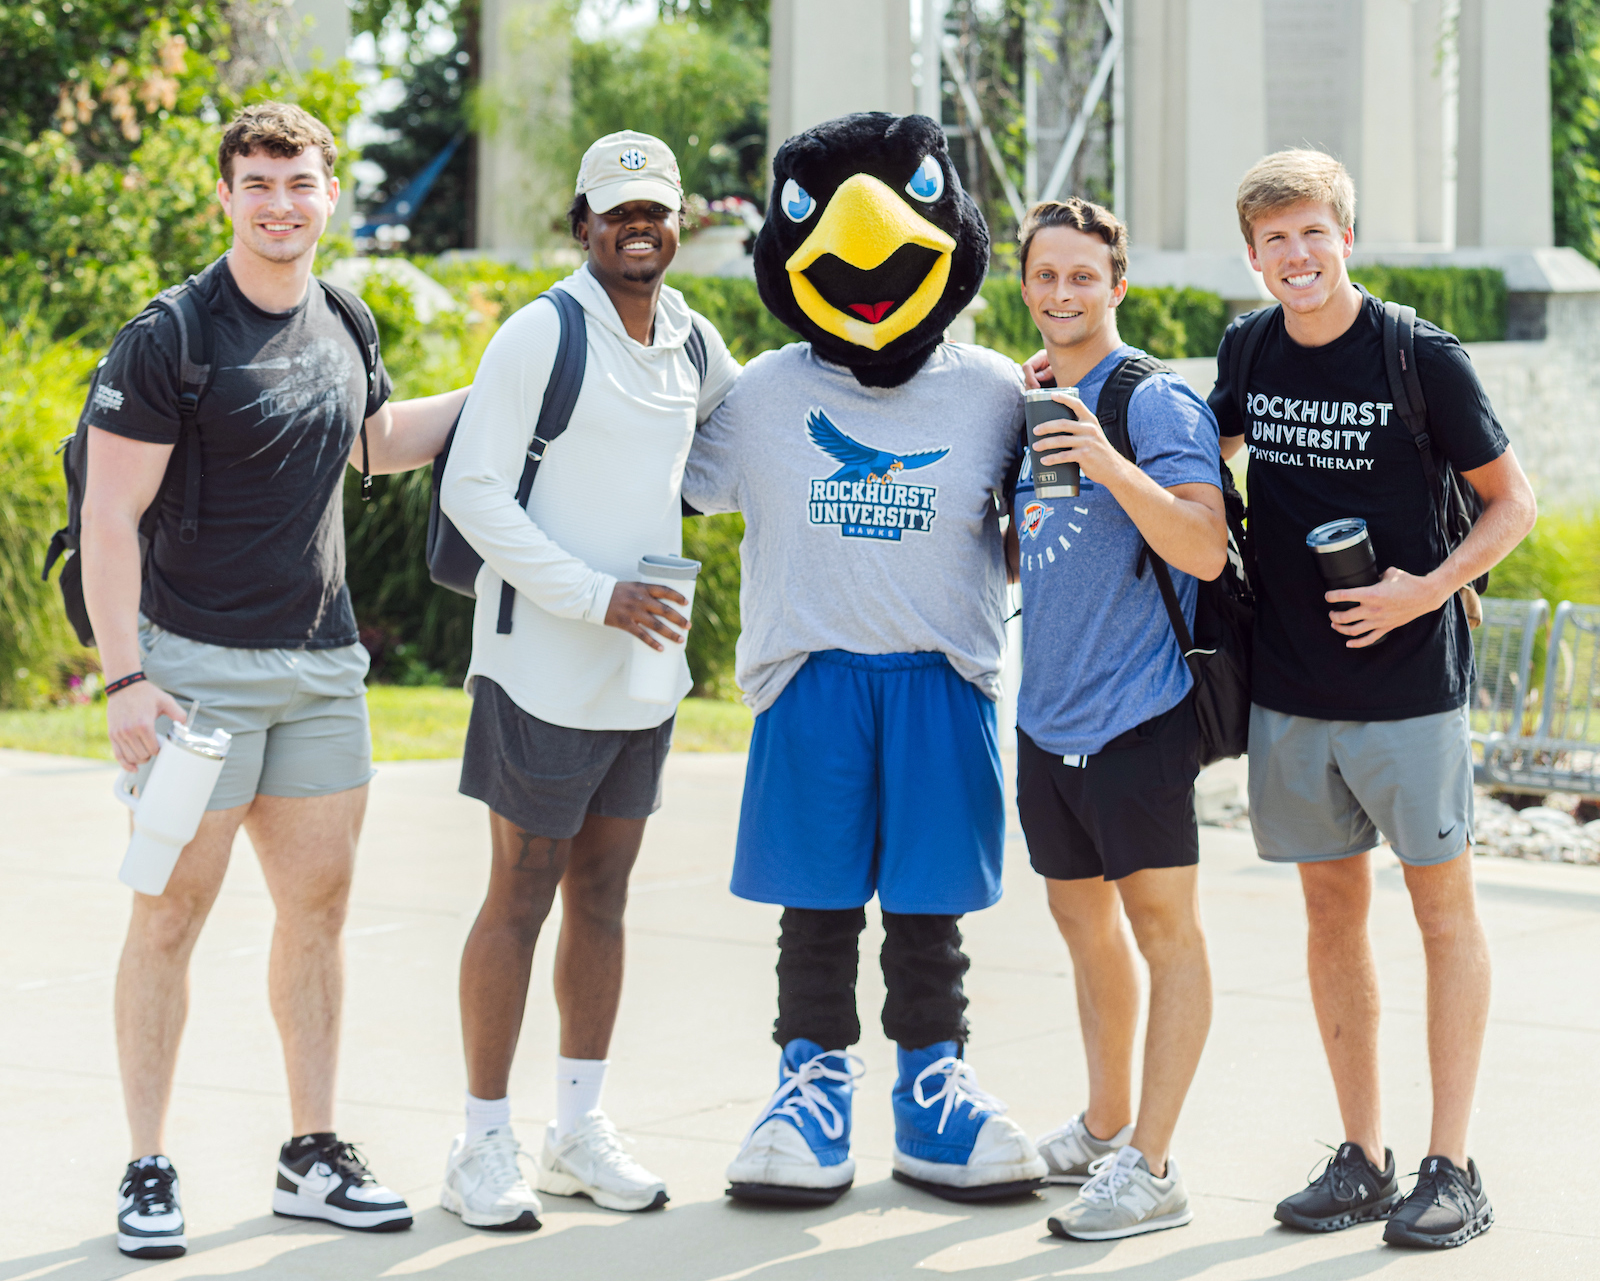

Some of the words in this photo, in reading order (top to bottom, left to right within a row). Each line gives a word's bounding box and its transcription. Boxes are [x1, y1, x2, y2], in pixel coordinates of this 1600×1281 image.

[620, 148, 647, 170] SEC
[1252, 420, 1371, 452] UNIVERSITY
[1248, 444, 1304, 467] PHYSICAL
[1307, 452, 1375, 471] THERAPY
[1036, 472, 1055, 483] YETI
[812, 480, 935, 509] ROCKHURST
[811, 502, 935, 532] UNIVERSITY
[848, 526, 894, 539] HAWKS
